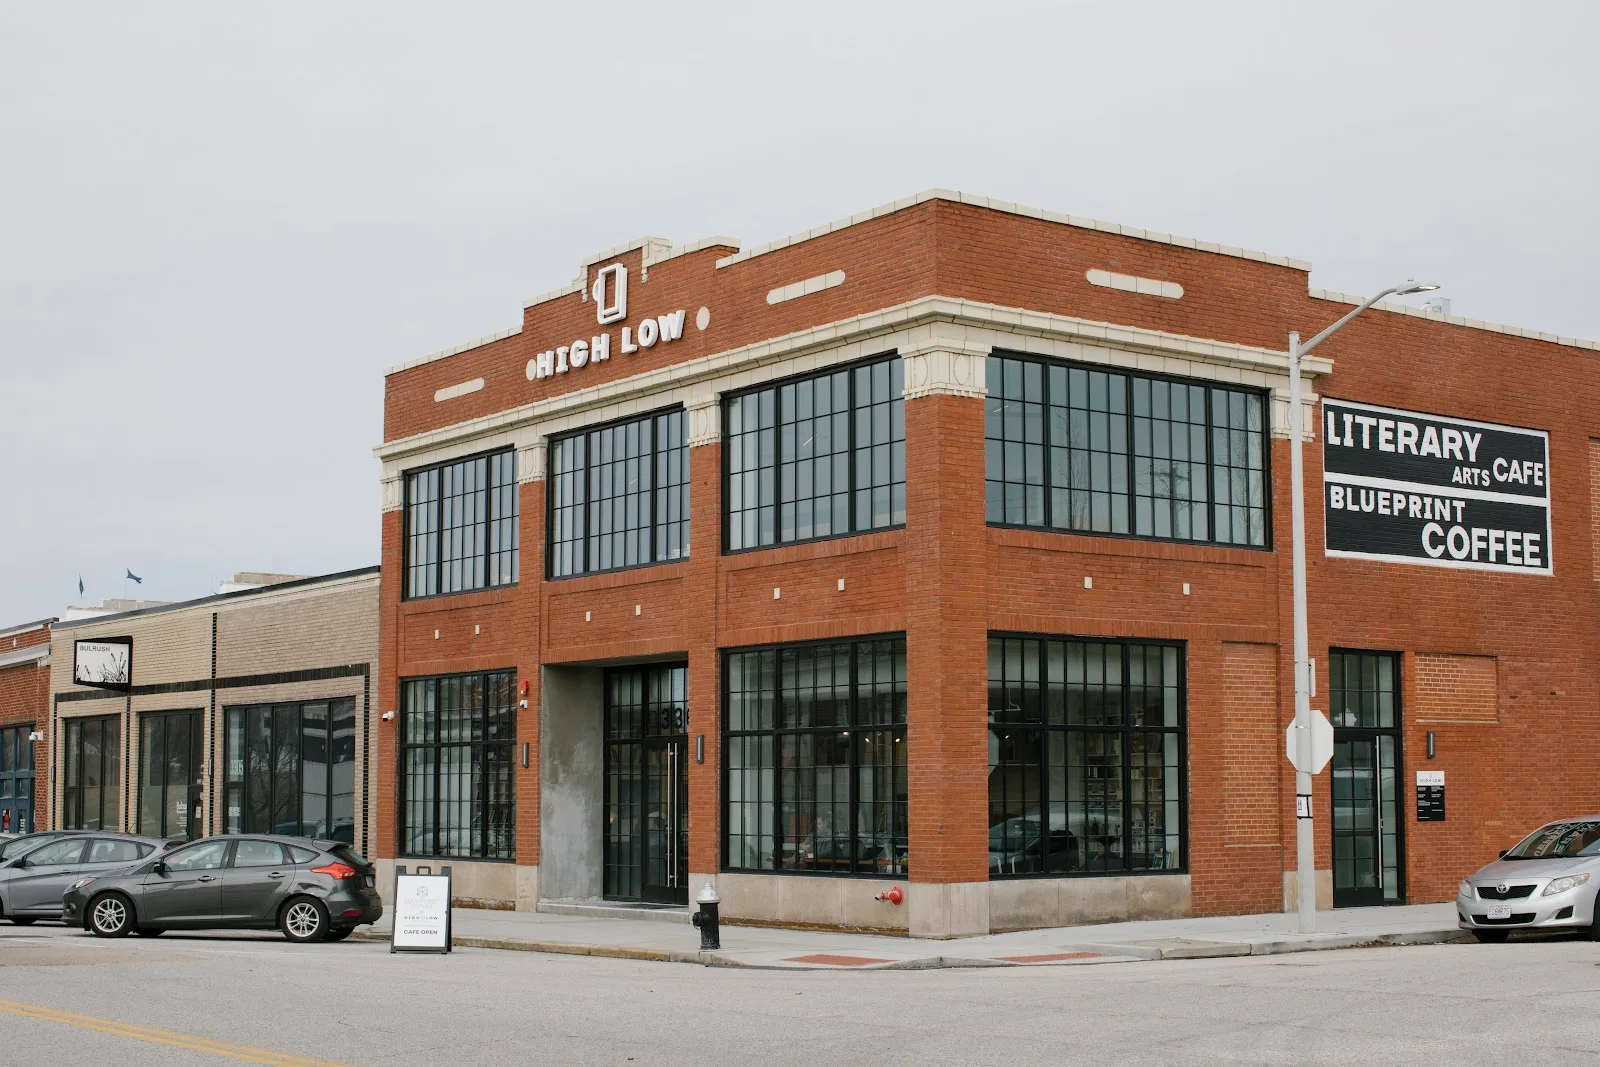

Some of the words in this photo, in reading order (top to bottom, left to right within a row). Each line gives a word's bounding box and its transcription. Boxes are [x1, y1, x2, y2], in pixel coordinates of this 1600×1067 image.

[536, 333, 610, 379] HIGH
[621, 310, 686, 354] LOW
[1327, 411, 1482, 462] LITERARY
[1452, 466, 1490, 486] ARTS
[1492, 457, 1544, 486] CAFE
[1330, 485, 1465, 523] BLUEPRINT
[1421, 522, 1541, 566] COFFEE
